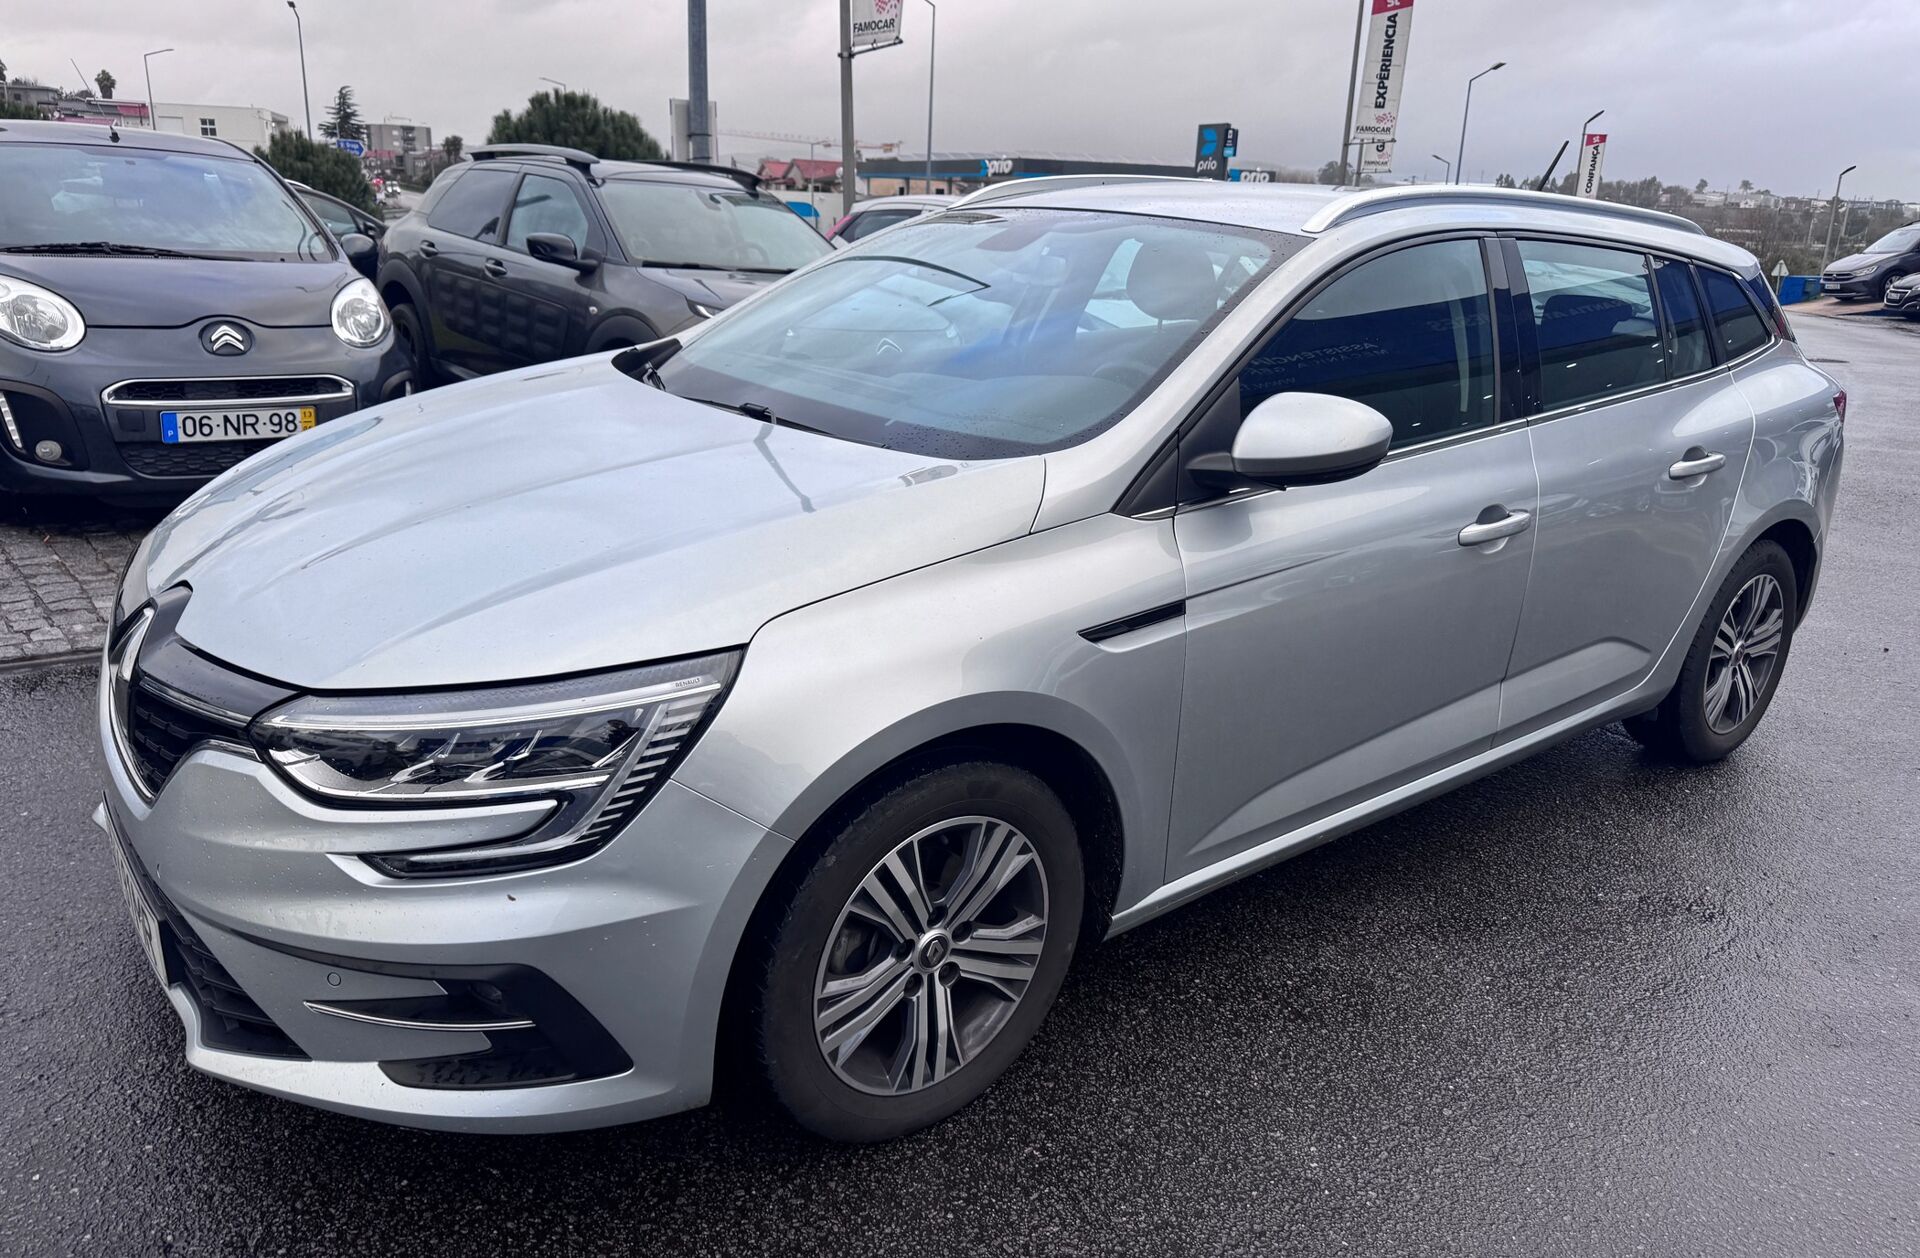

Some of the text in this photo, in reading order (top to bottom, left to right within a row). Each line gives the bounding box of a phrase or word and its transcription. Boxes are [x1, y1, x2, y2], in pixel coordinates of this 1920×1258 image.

[853, 18, 895, 32] FAMOCAR
[1197, 156, 1217, 173] prio
[1585, 145, 1600, 193] CONFIANÇA
[1241, 167, 1270, 183] prio
